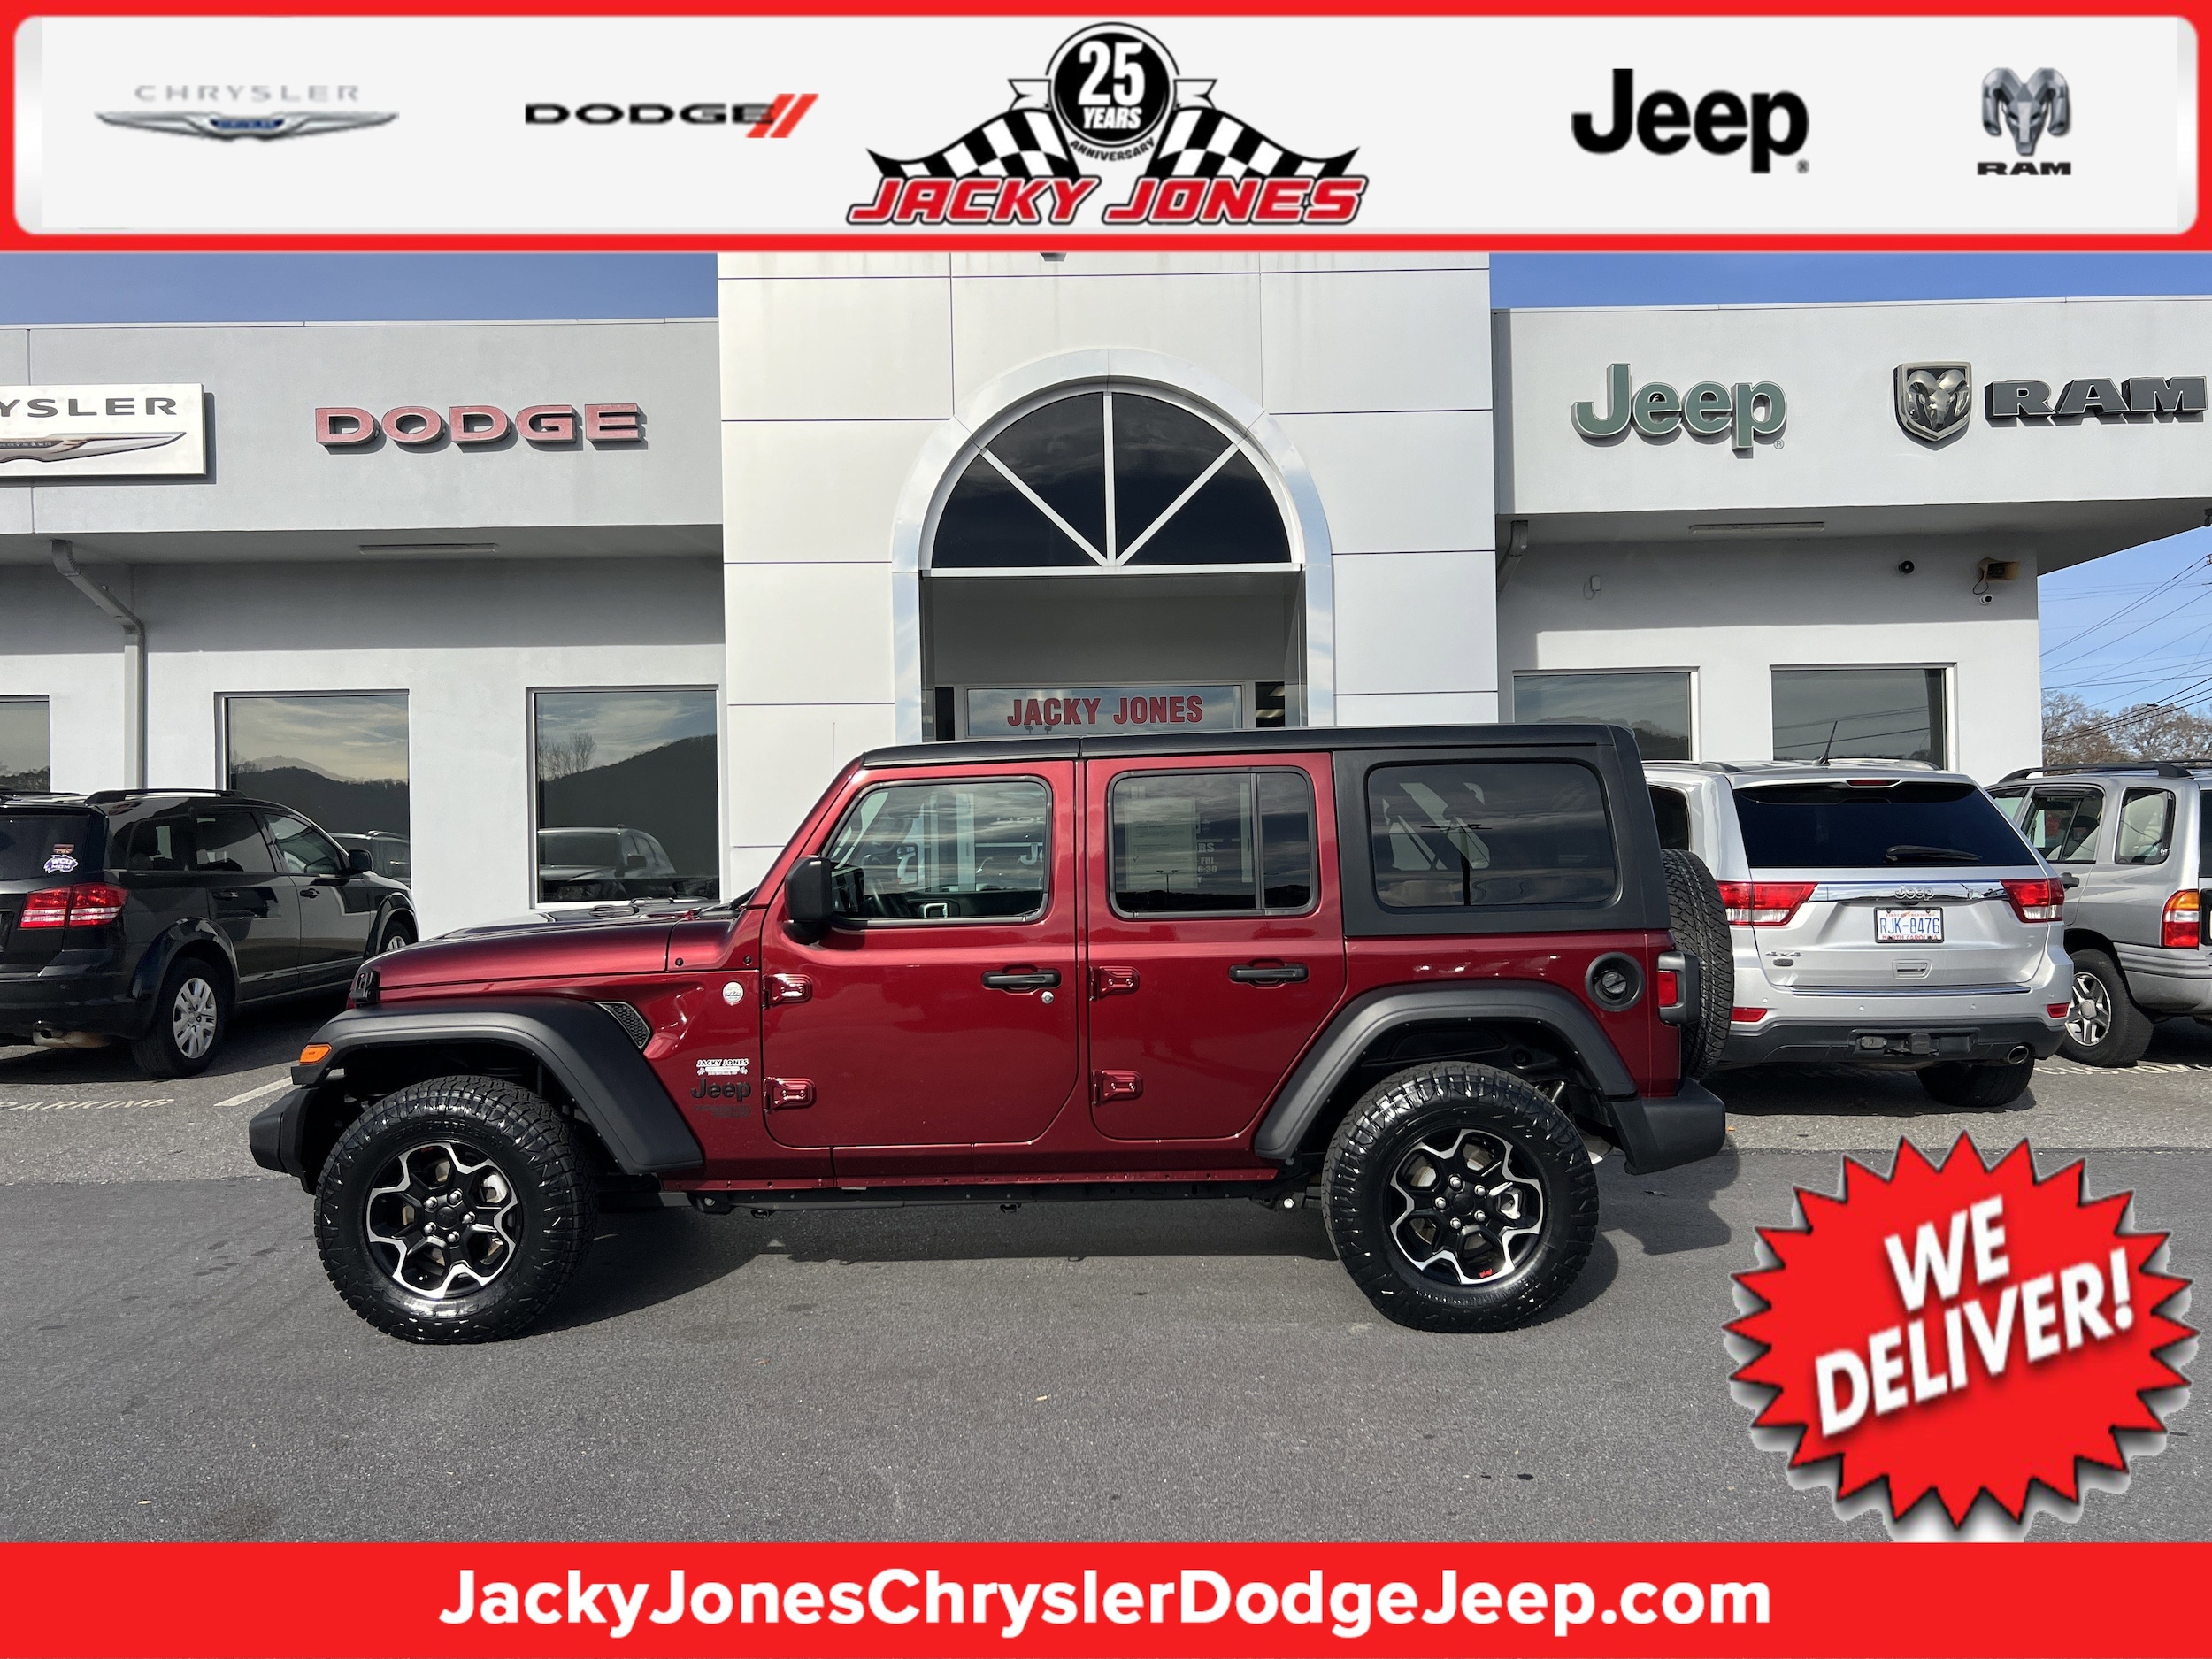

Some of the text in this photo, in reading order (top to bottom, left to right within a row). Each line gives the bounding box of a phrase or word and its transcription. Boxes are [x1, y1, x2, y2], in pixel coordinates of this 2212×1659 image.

[1572, 363, 1787, 450] Jeep
[1985, 376, 2208, 420] RAM
[314, 403, 643, 444] DODGE
[1007, 695, 1204, 726] JACKY JONES
[1894, 885, 1934, 901] Jeep
[1879, 918, 1940, 934] RJK-8476
[691, 1078, 751, 1102] Jeep
